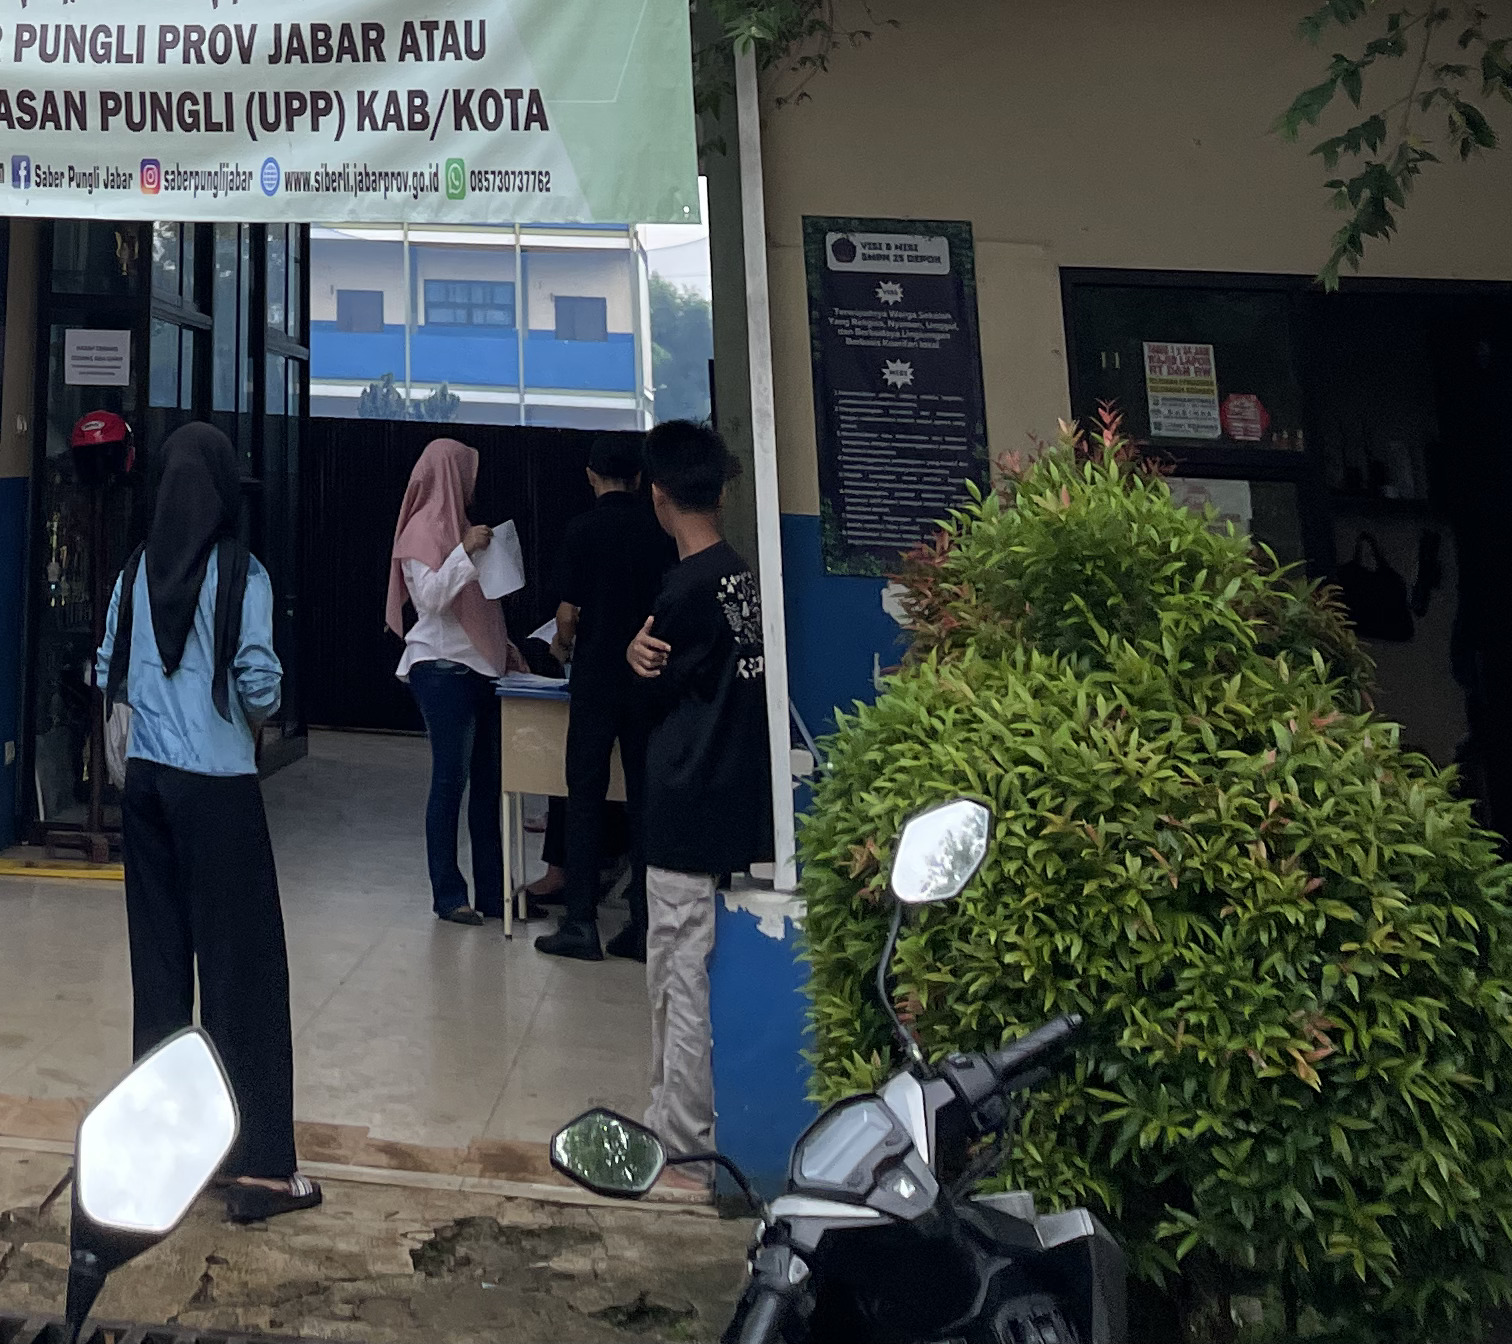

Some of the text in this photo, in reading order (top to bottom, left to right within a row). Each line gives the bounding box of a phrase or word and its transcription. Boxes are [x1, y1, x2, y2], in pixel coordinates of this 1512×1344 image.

[13, 23, 145, 65] PUNGLI
[157, 22, 259, 65] PROV
[267, 22, 387, 65] JABAR
[398, 18, 487, 63] ATAU
[99, 90, 235, 133] PUNGLI
[244, 90, 346, 142] (UPP)
[355, 88, 550, 142] KAB/KOTA
[35, 164, 65, 188] Saber
[68, 164, 100, 195] Pungli
[103, 166, 133, 190] Jabar
[164, 162, 253, 199] saberpunglijabar
